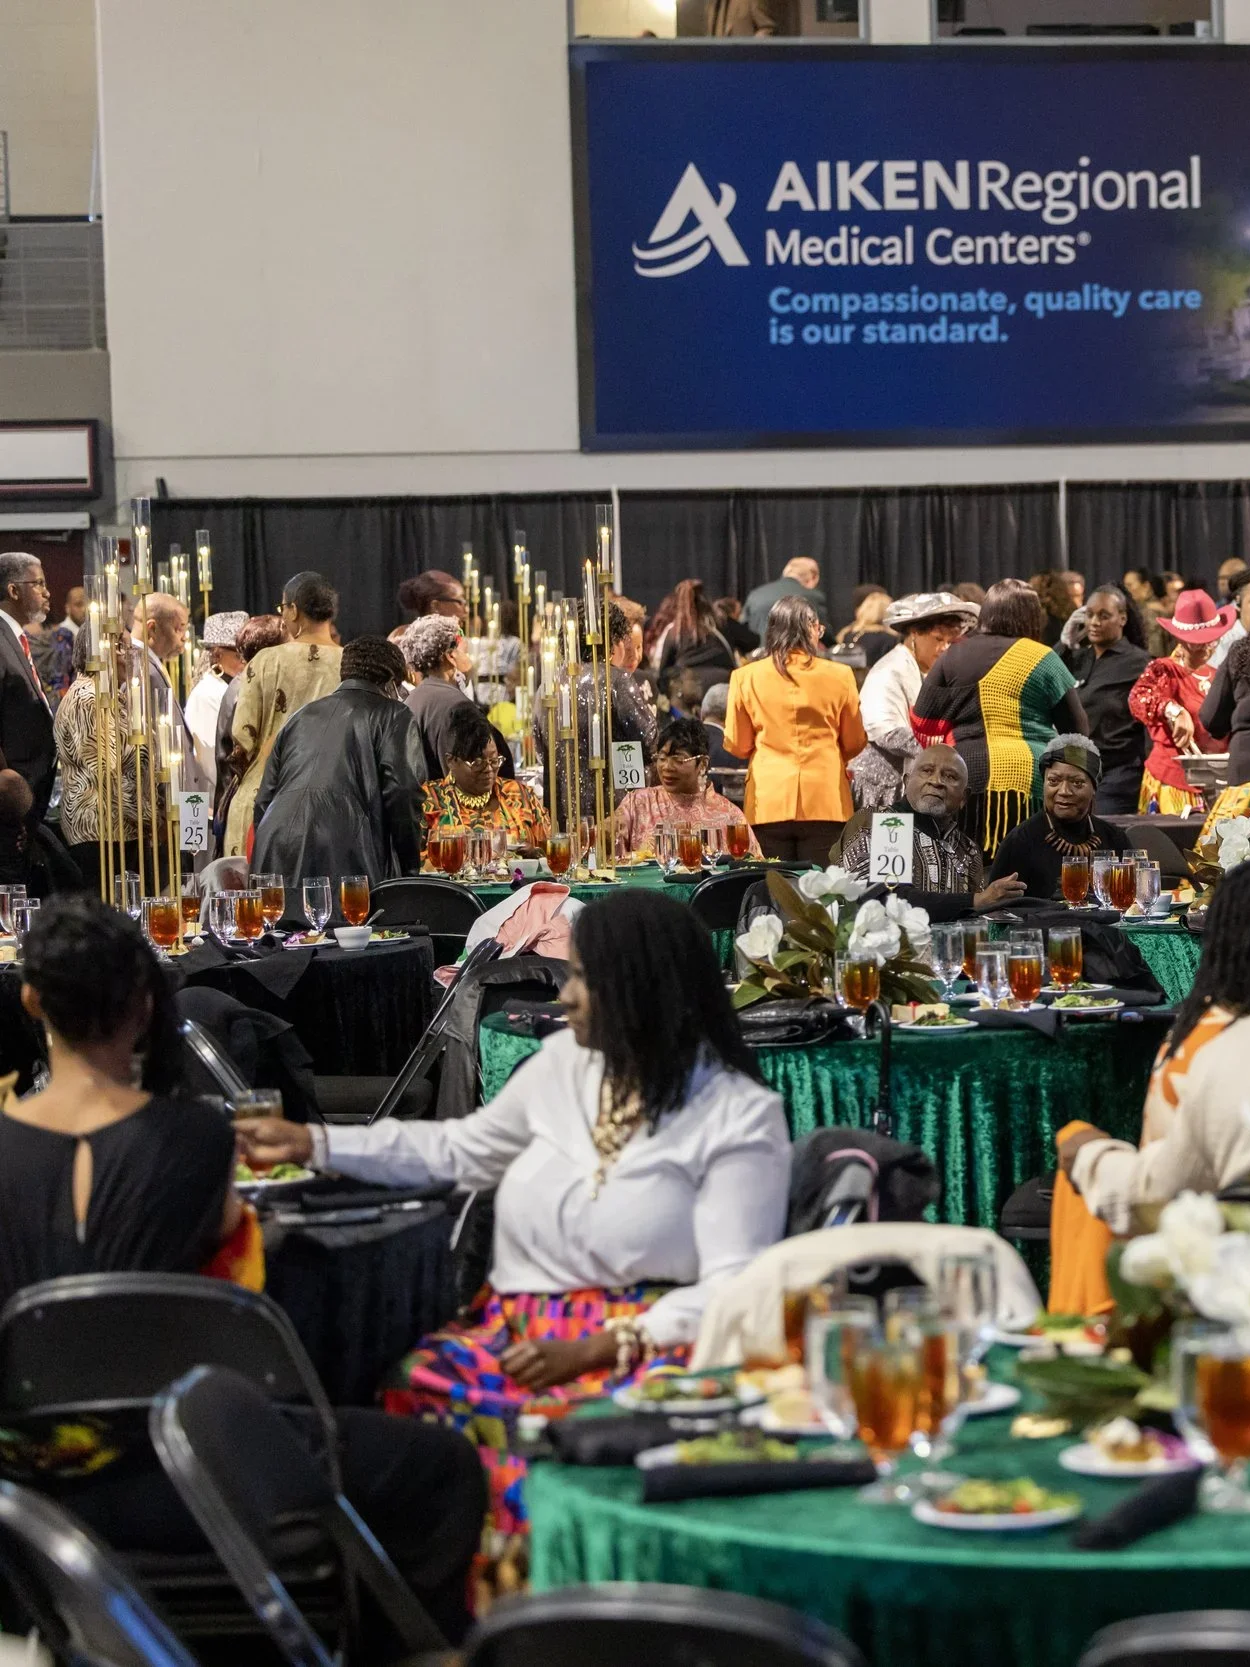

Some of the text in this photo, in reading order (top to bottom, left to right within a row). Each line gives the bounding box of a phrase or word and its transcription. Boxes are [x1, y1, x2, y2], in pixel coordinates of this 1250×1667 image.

[765, 225, 914, 266] Medical
[768, 283, 1202, 319] Compassionate, quality care
[769, 315, 1009, 345] is our standard.
[618, 769, 640, 785] 30
[184, 826, 204, 846] 25
[876, 854, 906, 877] 20
